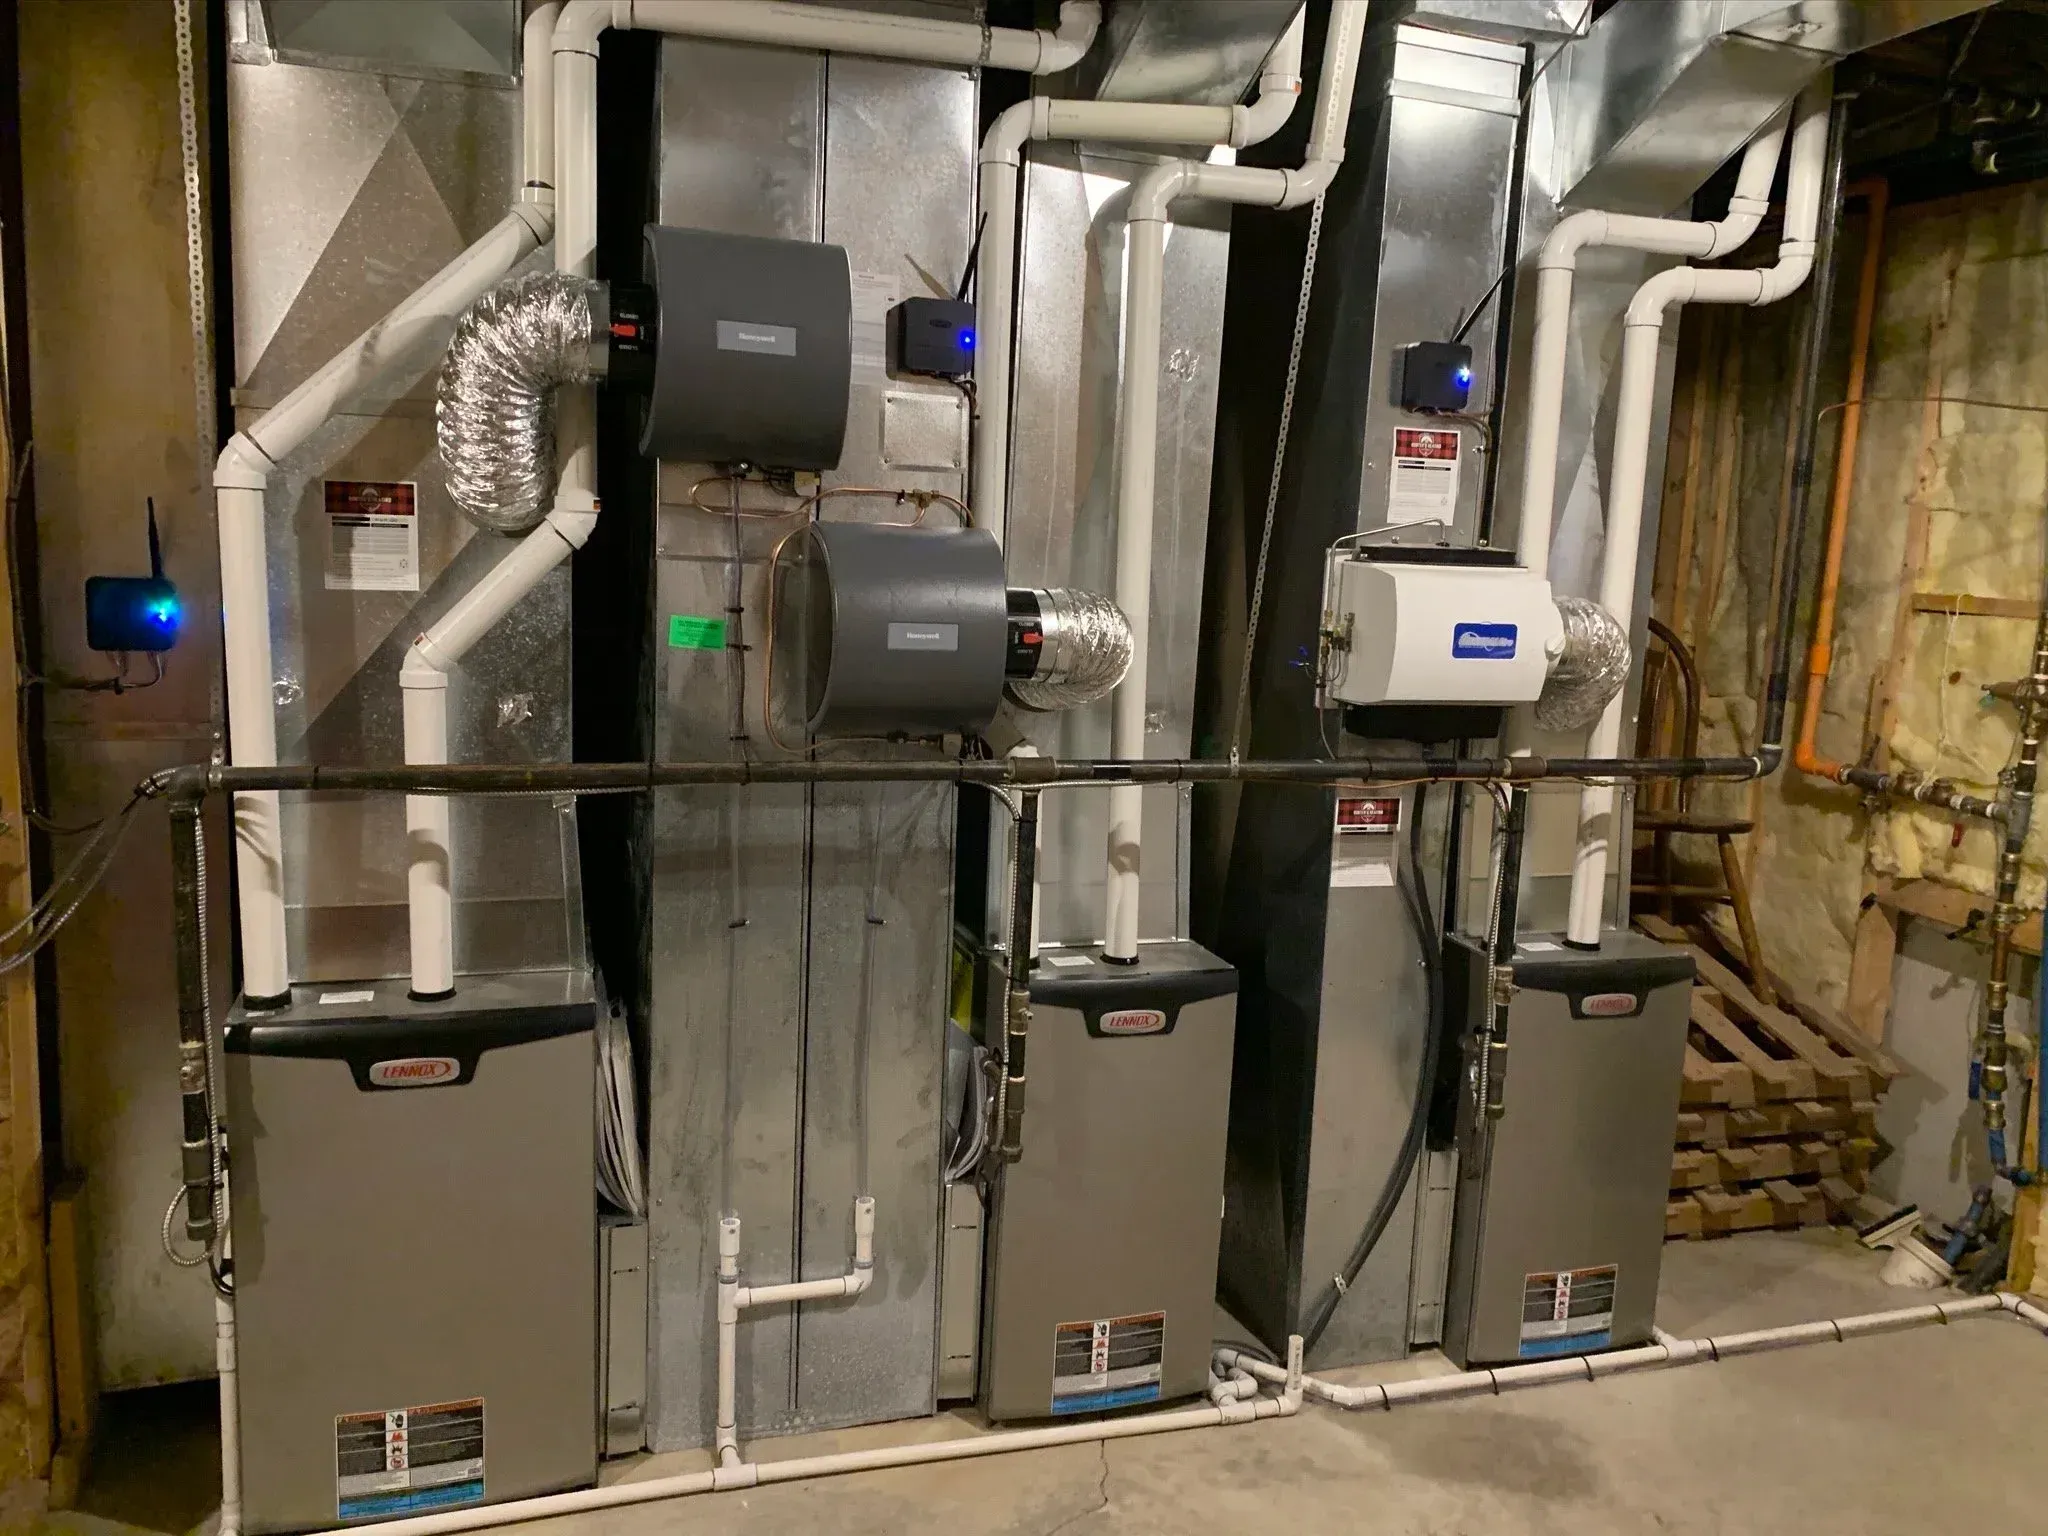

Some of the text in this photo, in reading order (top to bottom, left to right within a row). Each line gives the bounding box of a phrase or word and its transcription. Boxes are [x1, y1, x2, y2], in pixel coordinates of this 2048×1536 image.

[739, 332, 776, 344] Honeywell
[906, 631, 940, 641] Honeywell
[1109, 1015, 1151, 1027] LENNOX
[383, 1063, 437, 1078] LENNOX
